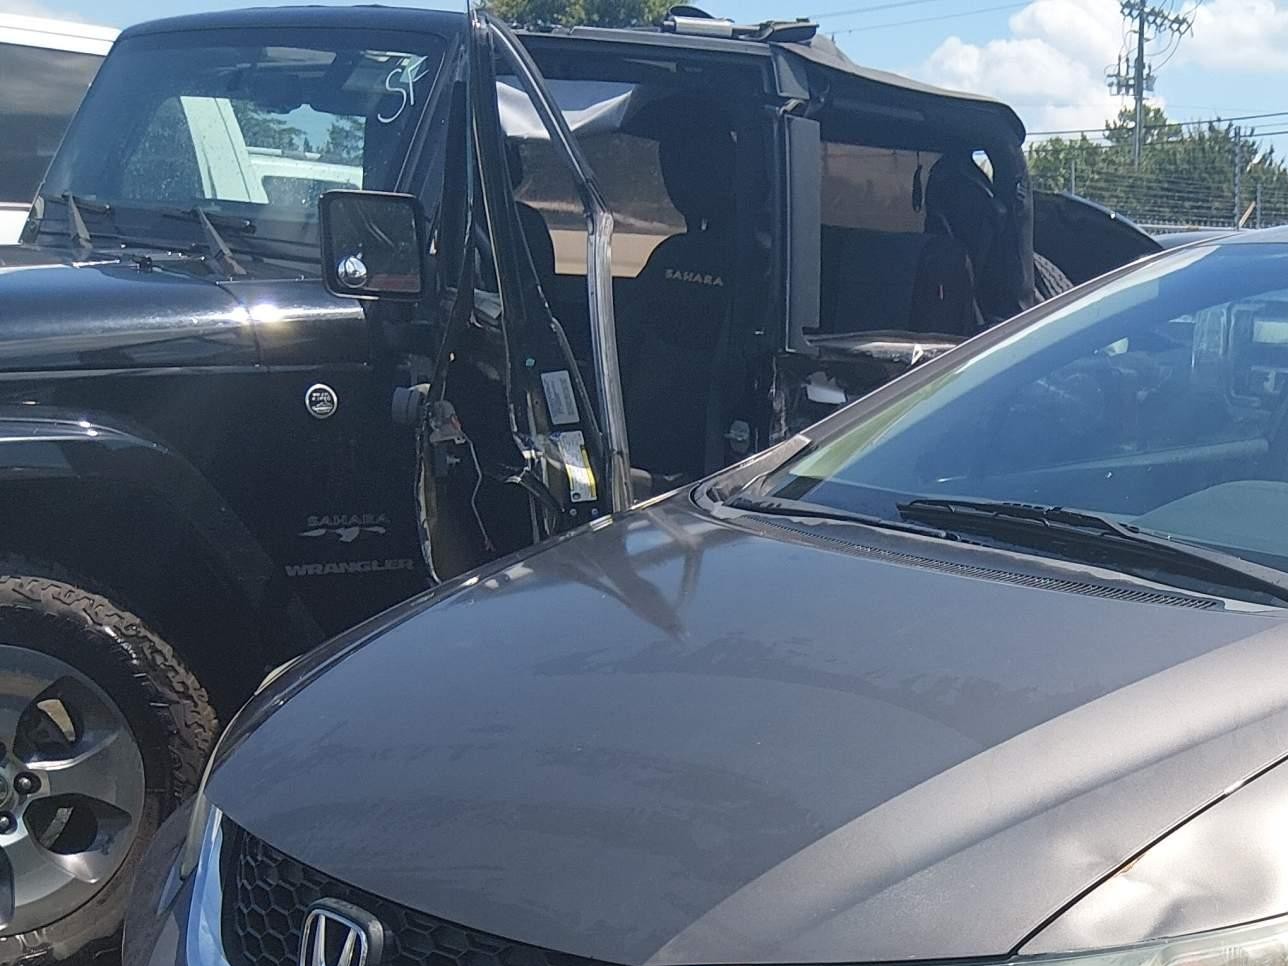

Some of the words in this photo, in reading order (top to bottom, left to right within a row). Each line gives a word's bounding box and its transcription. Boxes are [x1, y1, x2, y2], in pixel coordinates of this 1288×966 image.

[664, 268, 724, 287] SAHARA
[307, 513, 390, 527] SAHARA
[284, 559, 415, 577] WRANGLER
